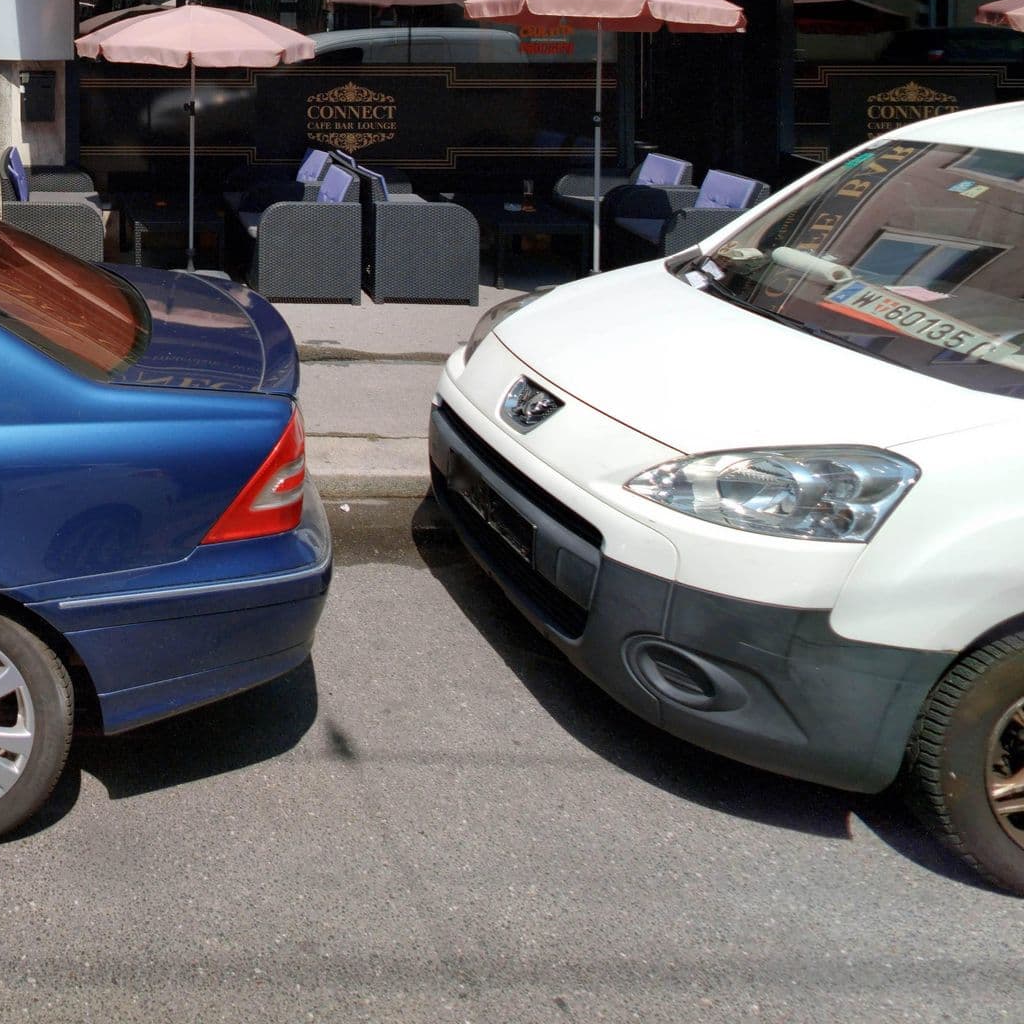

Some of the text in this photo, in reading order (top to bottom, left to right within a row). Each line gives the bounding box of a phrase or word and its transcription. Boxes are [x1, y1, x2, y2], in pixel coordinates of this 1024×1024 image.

[307, 105, 397, 120] CONNECT
[307, 121, 397, 130] CAFE BAR LOUNGE
